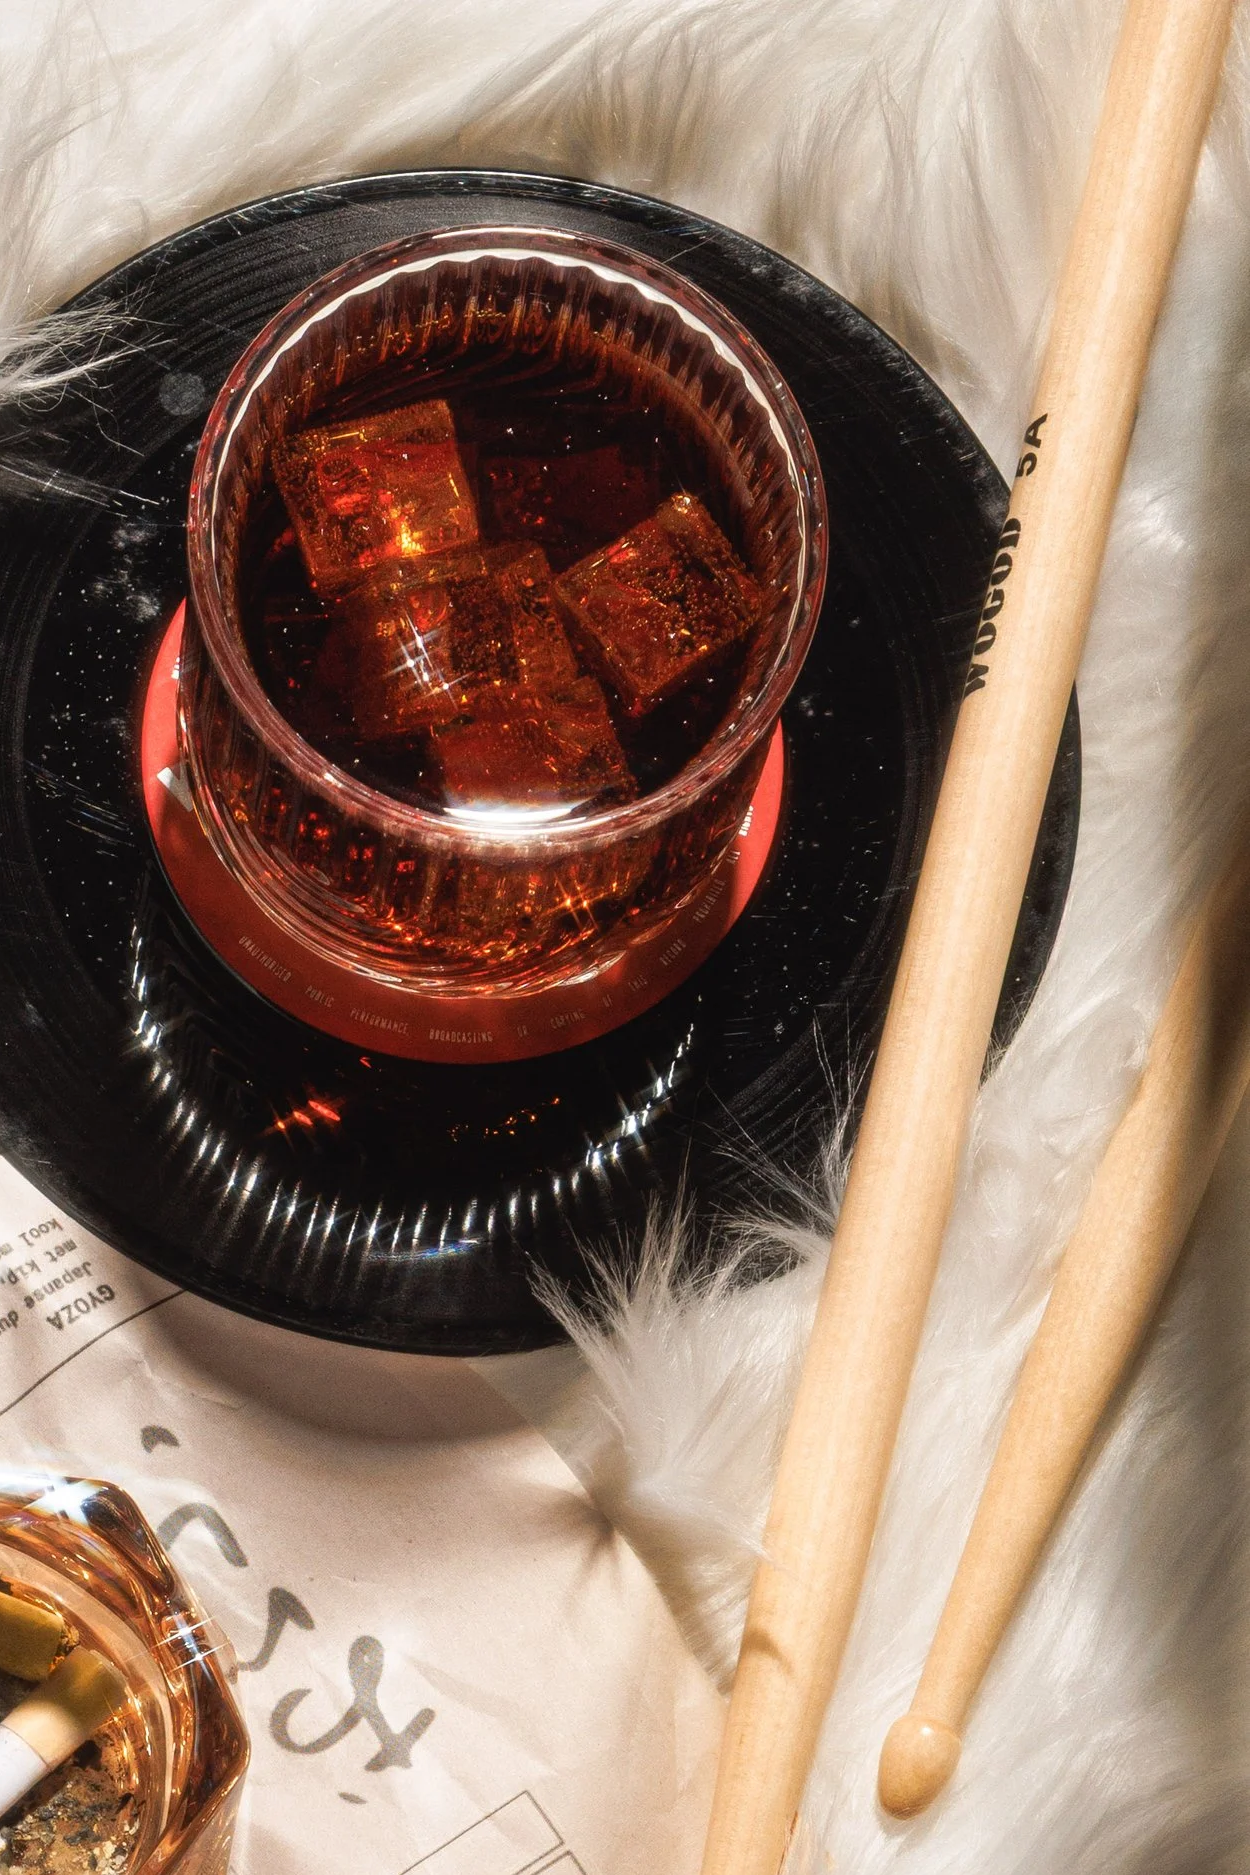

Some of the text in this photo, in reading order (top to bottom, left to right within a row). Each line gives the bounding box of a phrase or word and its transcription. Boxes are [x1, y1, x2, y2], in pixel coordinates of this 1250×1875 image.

[1014, 413, 1048, 478] 5A
[305, 985, 334, 1008] PUBLIC
[429, 1028, 494, 1044] BROADCASTING
[18, 1217, 63, 1247] kool
[0, 1259, 41, 1286] kip,
[23, 1260, 92, 1310] Japanse
[45, 1283, 115, 1331] GYOZA
